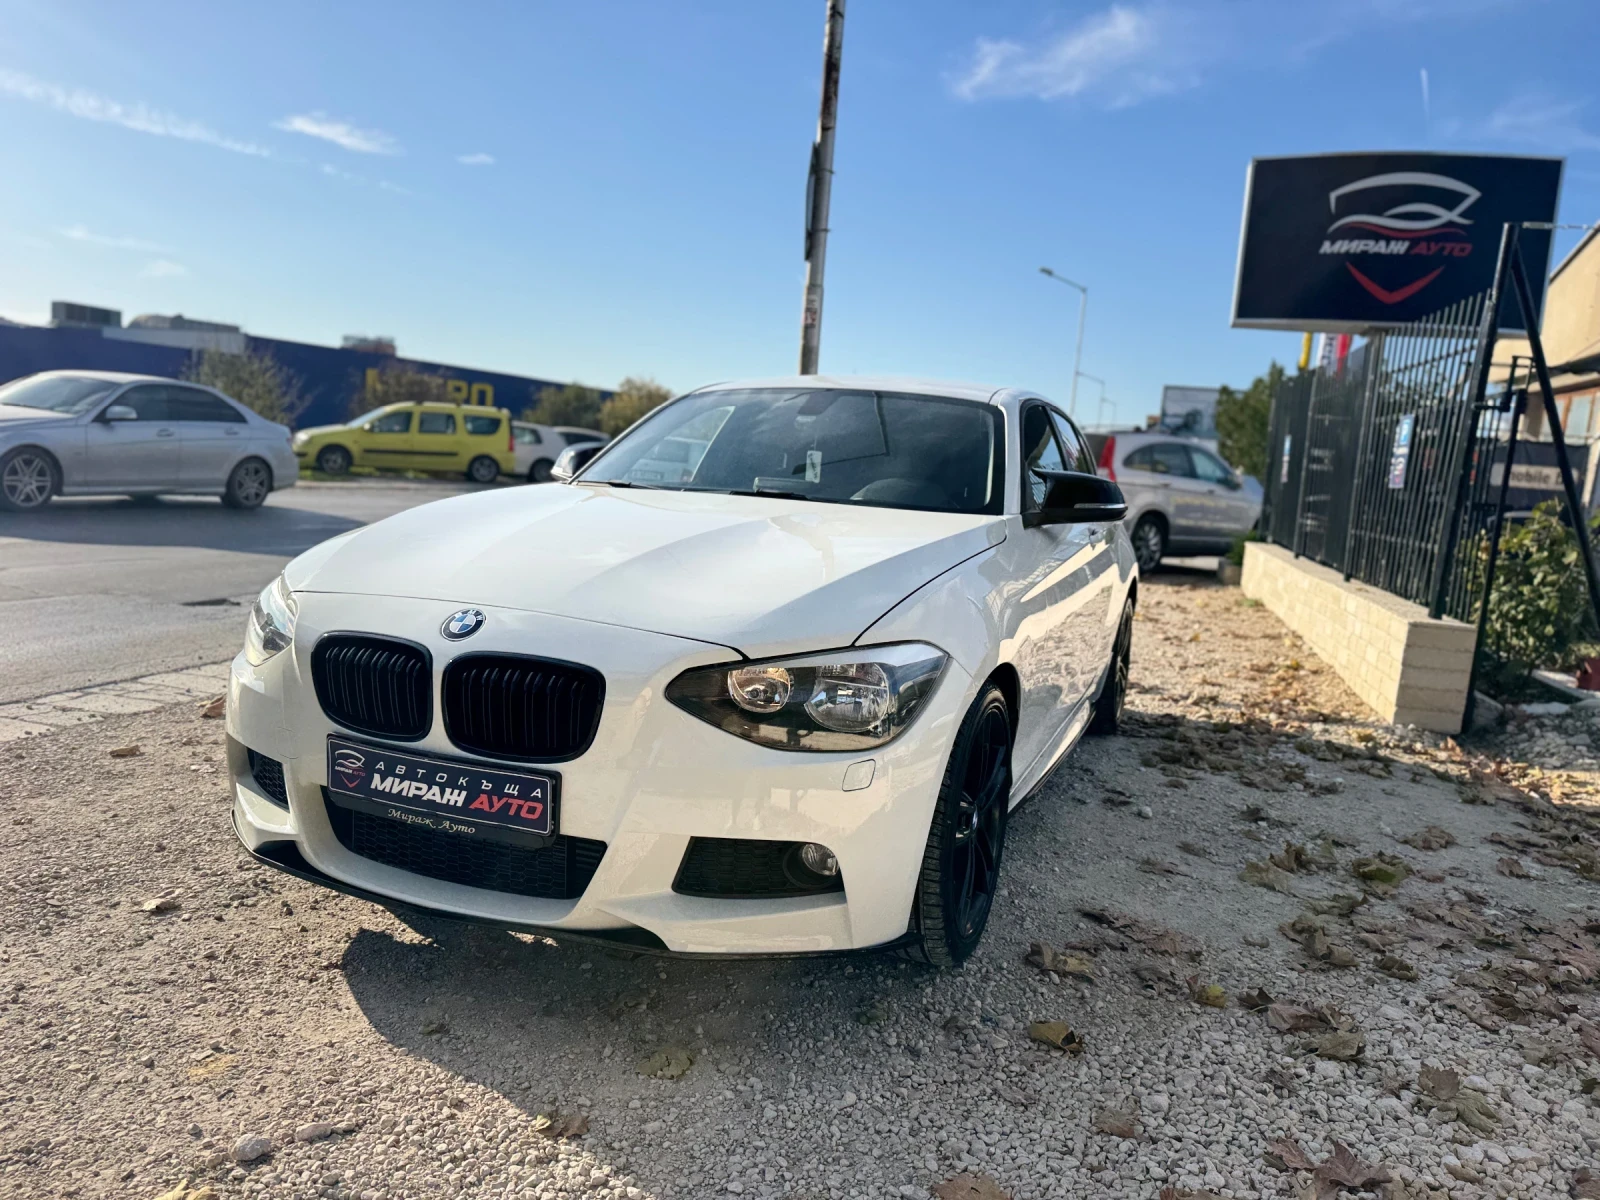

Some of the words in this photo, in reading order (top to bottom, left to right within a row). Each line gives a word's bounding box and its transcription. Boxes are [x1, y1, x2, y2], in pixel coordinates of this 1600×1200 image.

[1319, 240, 1410, 254] МИРАЖ
[1411, 242, 1473, 257] АУТО
[375, 761, 543, 798] АВТОКЪЩА
[370, 773, 468, 807] МИРАЖ
[468, 793, 544, 820] АУТО
[387, 808, 436, 829] Мираж
[438, 820, 476, 834] Ауто
